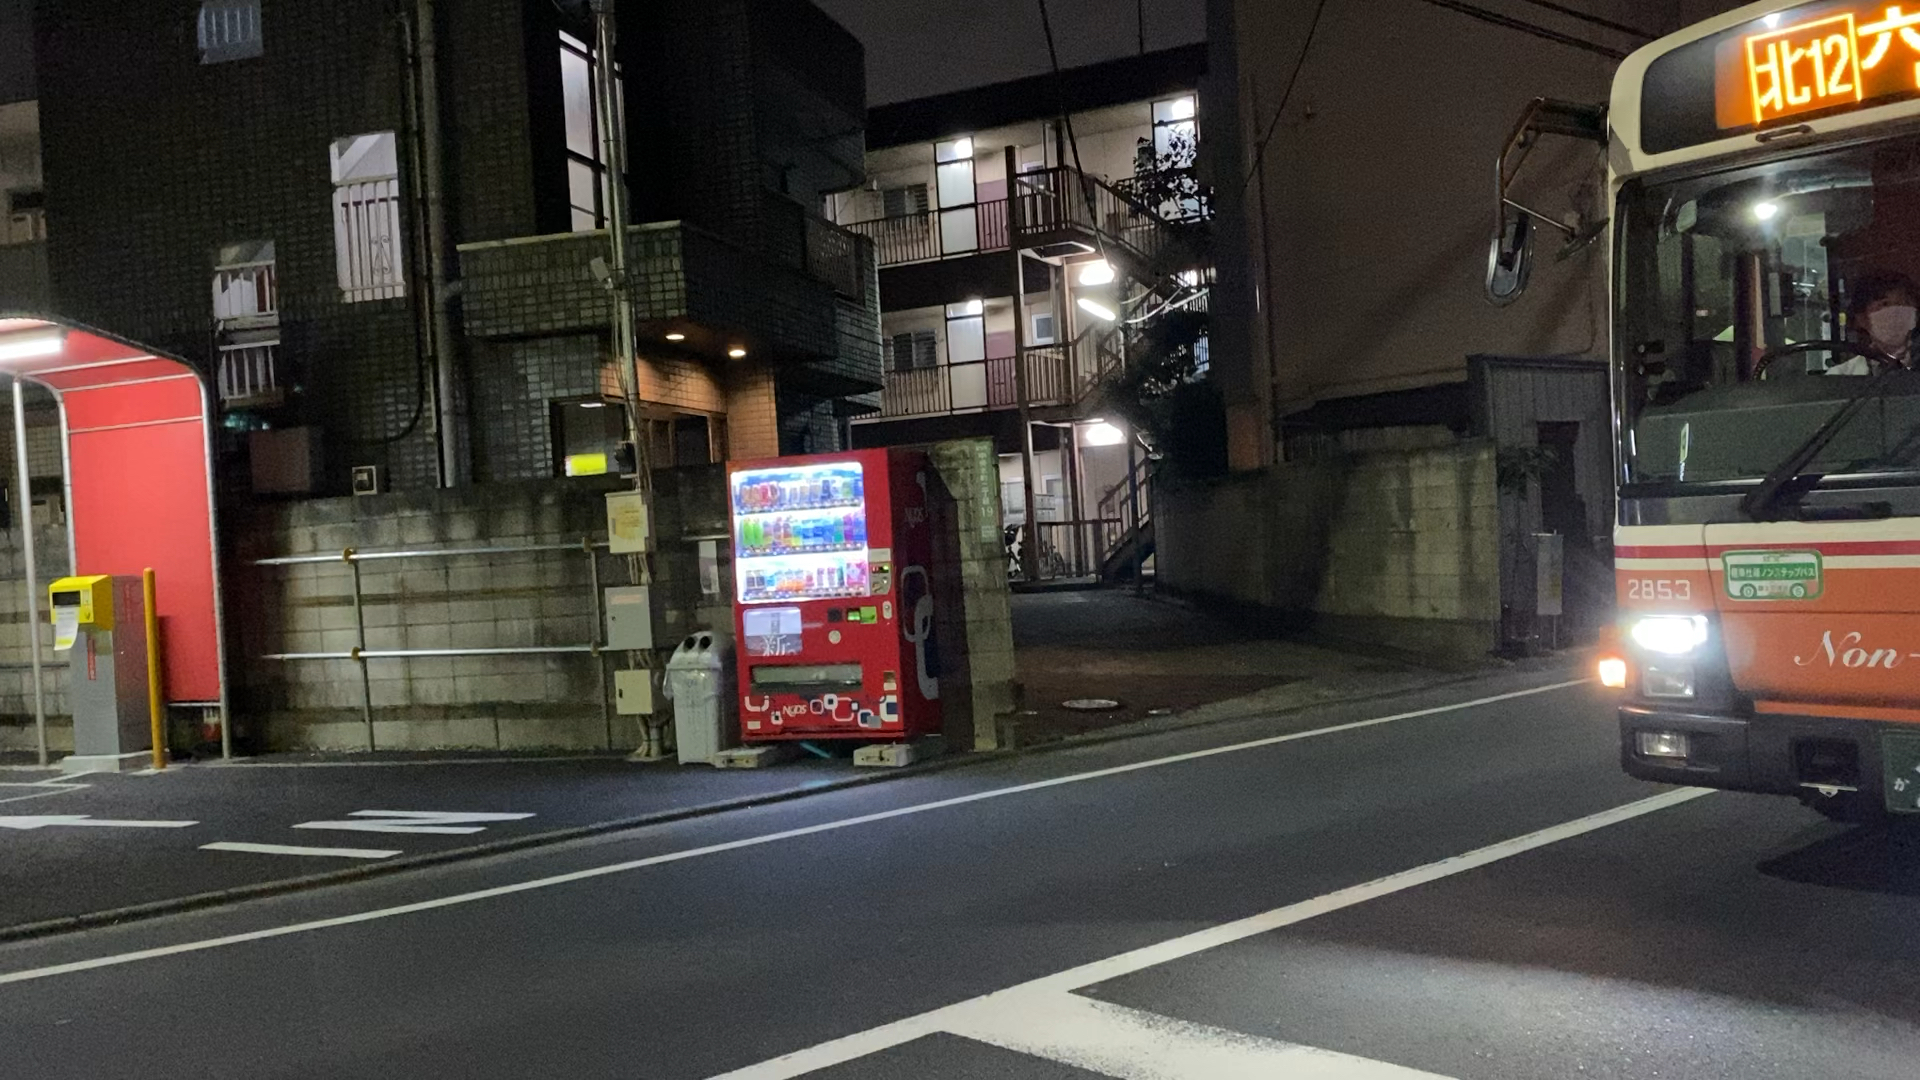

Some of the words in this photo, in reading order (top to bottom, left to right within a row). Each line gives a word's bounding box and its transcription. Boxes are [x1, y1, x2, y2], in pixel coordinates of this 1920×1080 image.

[1755, 32, 1854, 111] 北12
[981, 505, 994, 518] 19
[1731, 566, 1816, 579] 仕ノンテップバス
[1628, 579, 1690, 600] 2853
